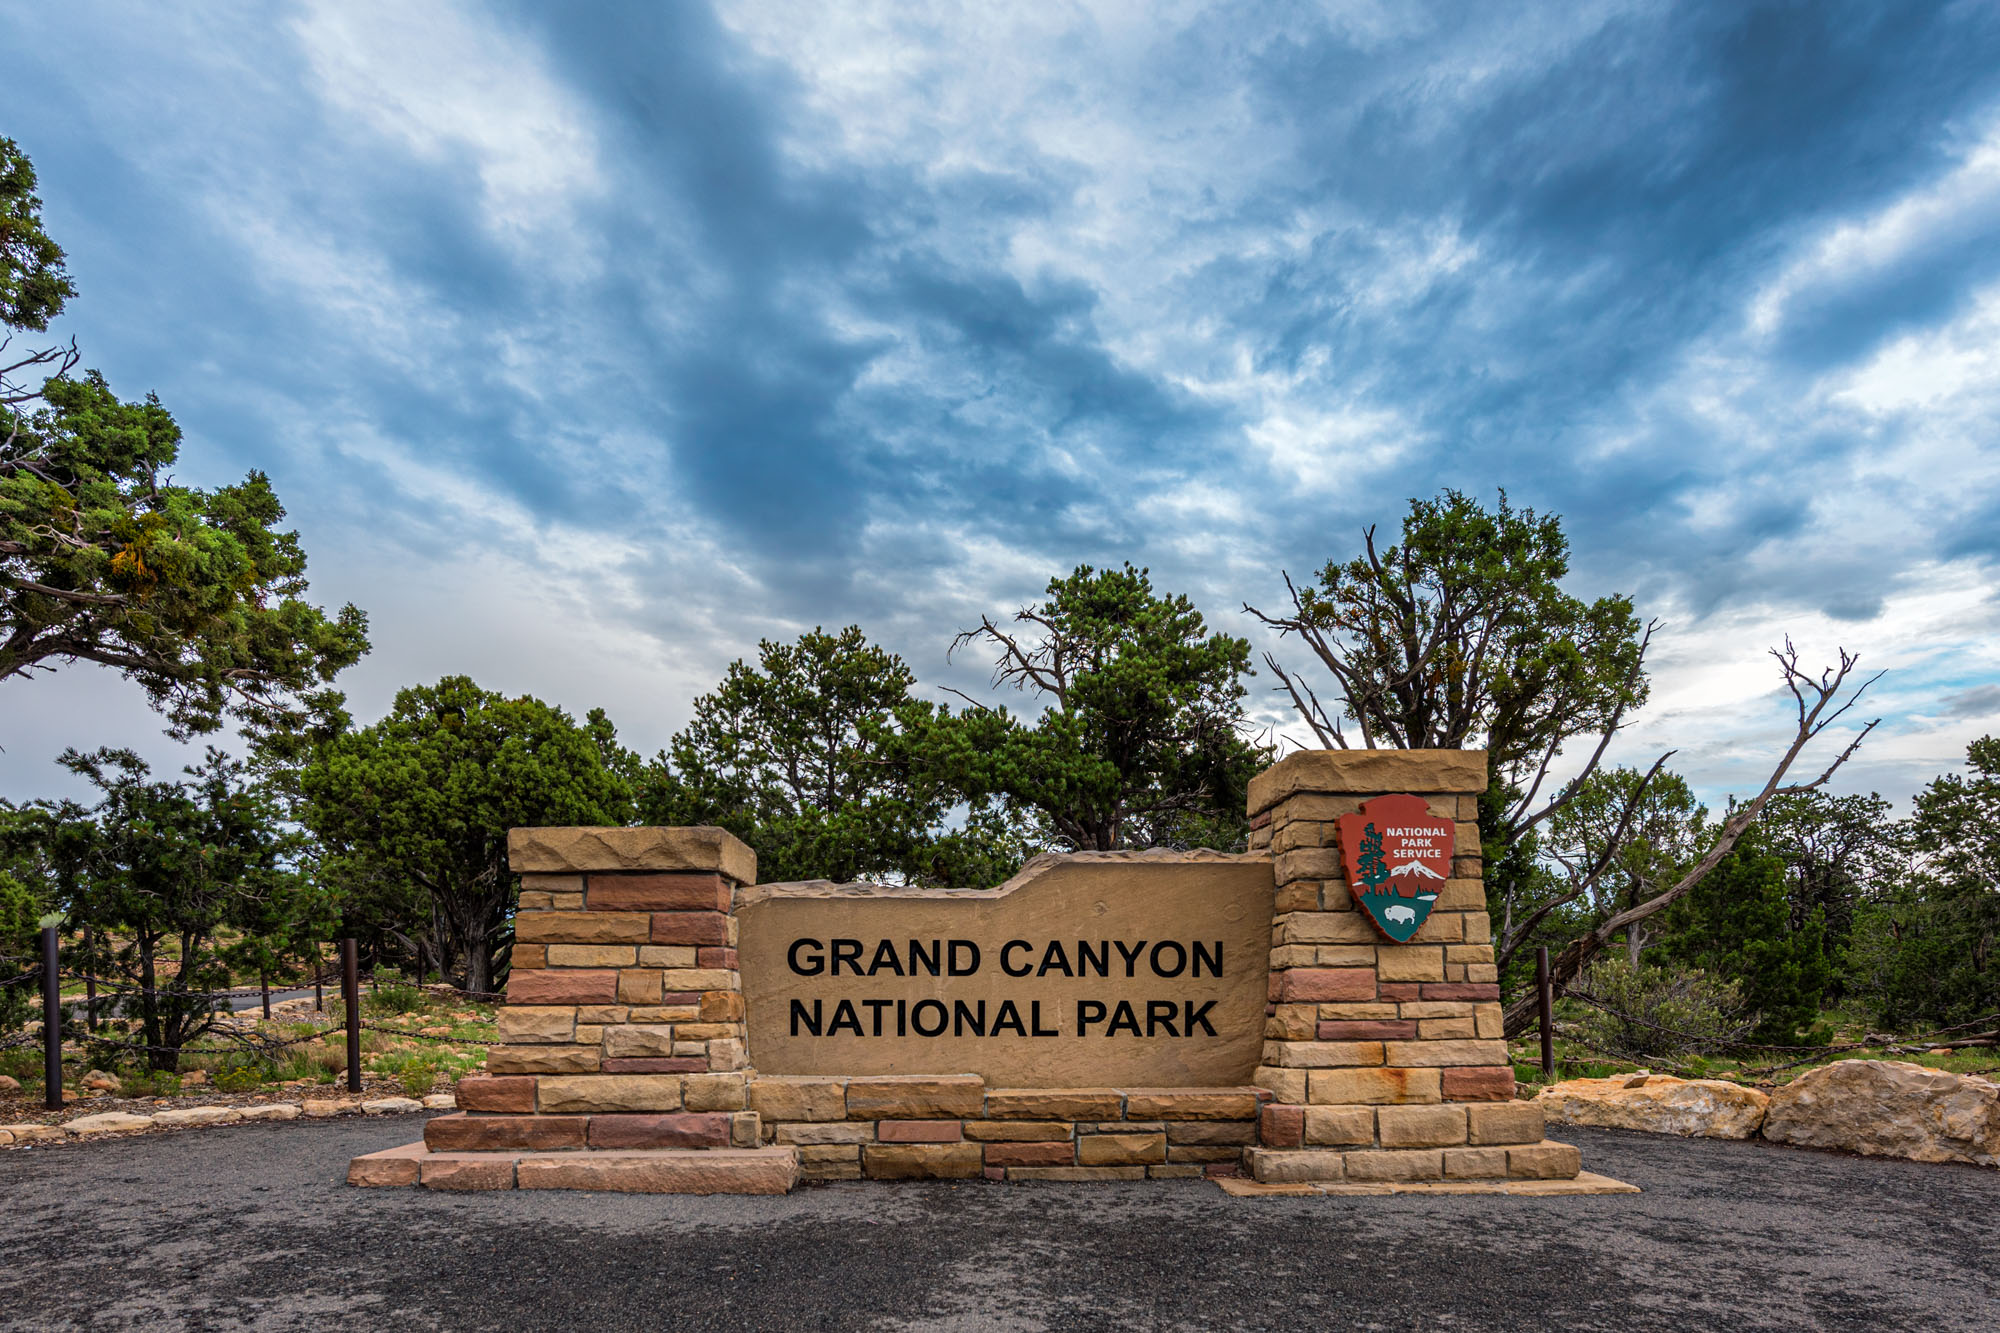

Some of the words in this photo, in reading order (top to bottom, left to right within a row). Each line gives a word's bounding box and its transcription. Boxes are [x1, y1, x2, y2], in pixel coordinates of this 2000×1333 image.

[1386, 827, 1447, 837] NATIONAL
[1401, 838, 1432, 847] PARK
[1393, 849, 1441, 858] SERVICE
[787, 938, 981, 977] GRAND
[999, 939, 1223, 978] CANYON
[790, 999, 1059, 1037] NATIONAL
[1077, 1000, 1219, 1037] PARK
